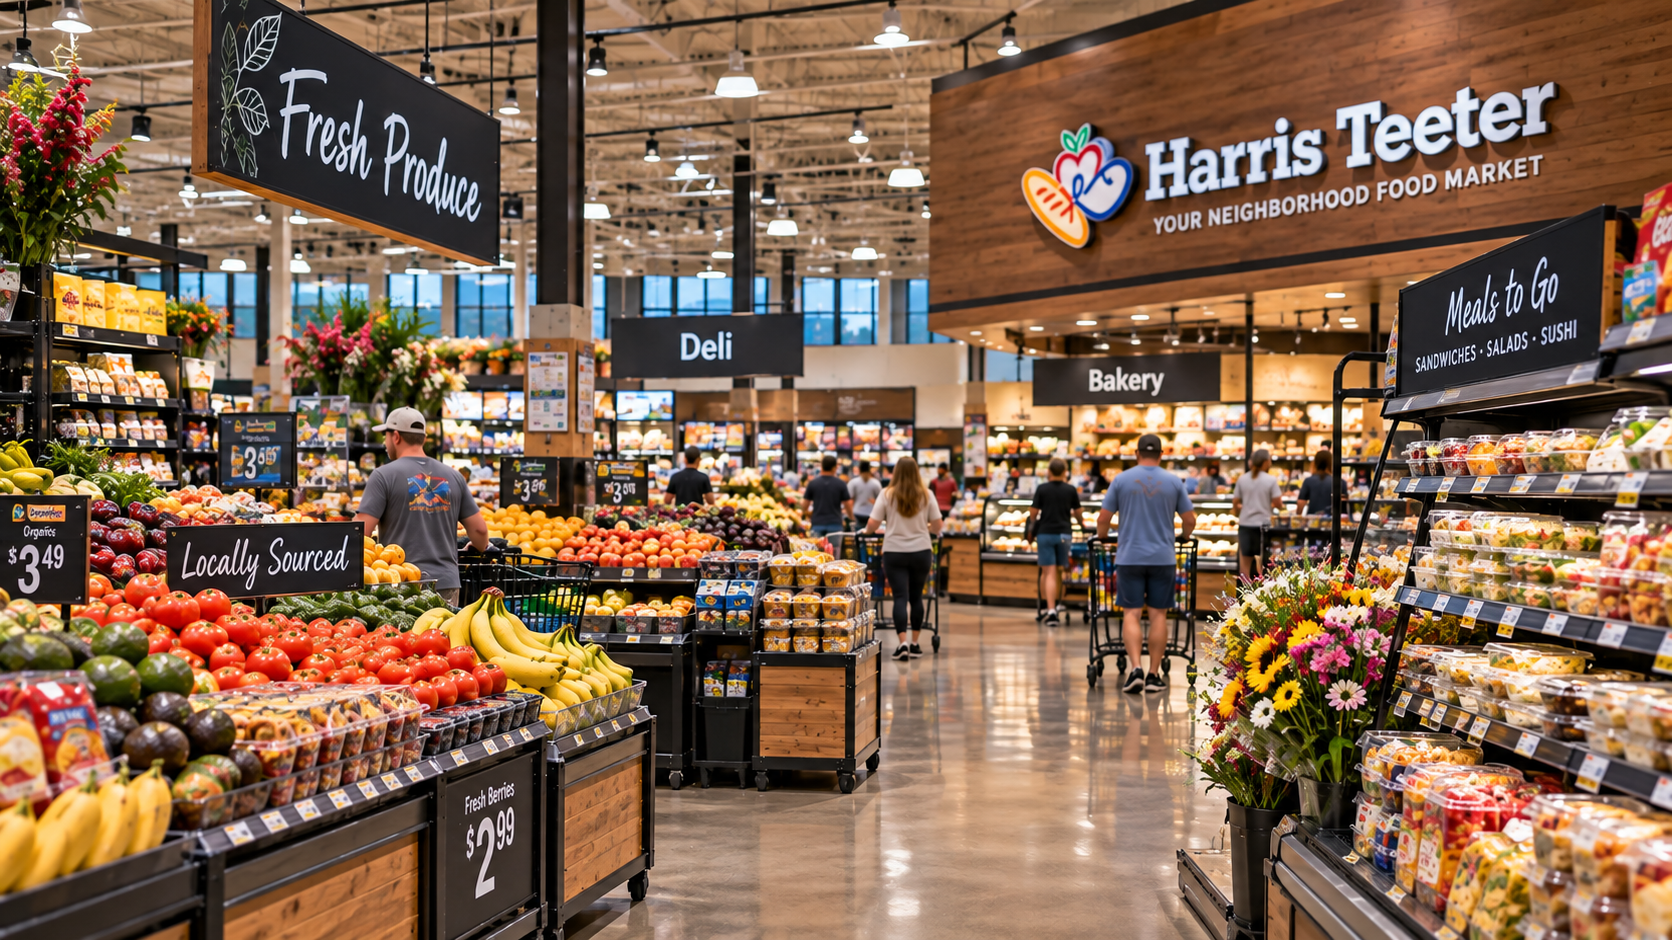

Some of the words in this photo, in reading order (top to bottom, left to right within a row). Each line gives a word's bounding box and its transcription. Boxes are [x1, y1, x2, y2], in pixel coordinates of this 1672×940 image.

[279, 68, 373, 180] Fresh
[383, 112, 482, 222] Produce
[1145, 117, 1328, 201] Harris
[1336, 82, 1557, 169] Teeter
[1153, 213, 1202, 235] YOUR
[1207, 185, 1370, 227] NEIGHBORHOOD
[1376, 174, 1438, 201] FOOD
[1444, 155, 1544, 190] MARKET
[1444, 274, 1500, 336] Meals
[1504, 268, 1524, 318] to
[1530, 256, 1559, 314] Go
[680, 331, 733, 361] Deli
[1415, 344, 1477, 374] SANDWICHES
[1486, 331, 1529, 358] SALADS
[1540, 319, 1577, 346] SUSHI
[1088, 366, 1165, 397] Bakery
[181, 538, 260, 590] Locally
[267, 535, 350, 576] Sourced
[464, 790, 486, 815] Fresh
[488, 782, 515, 806] Berries
